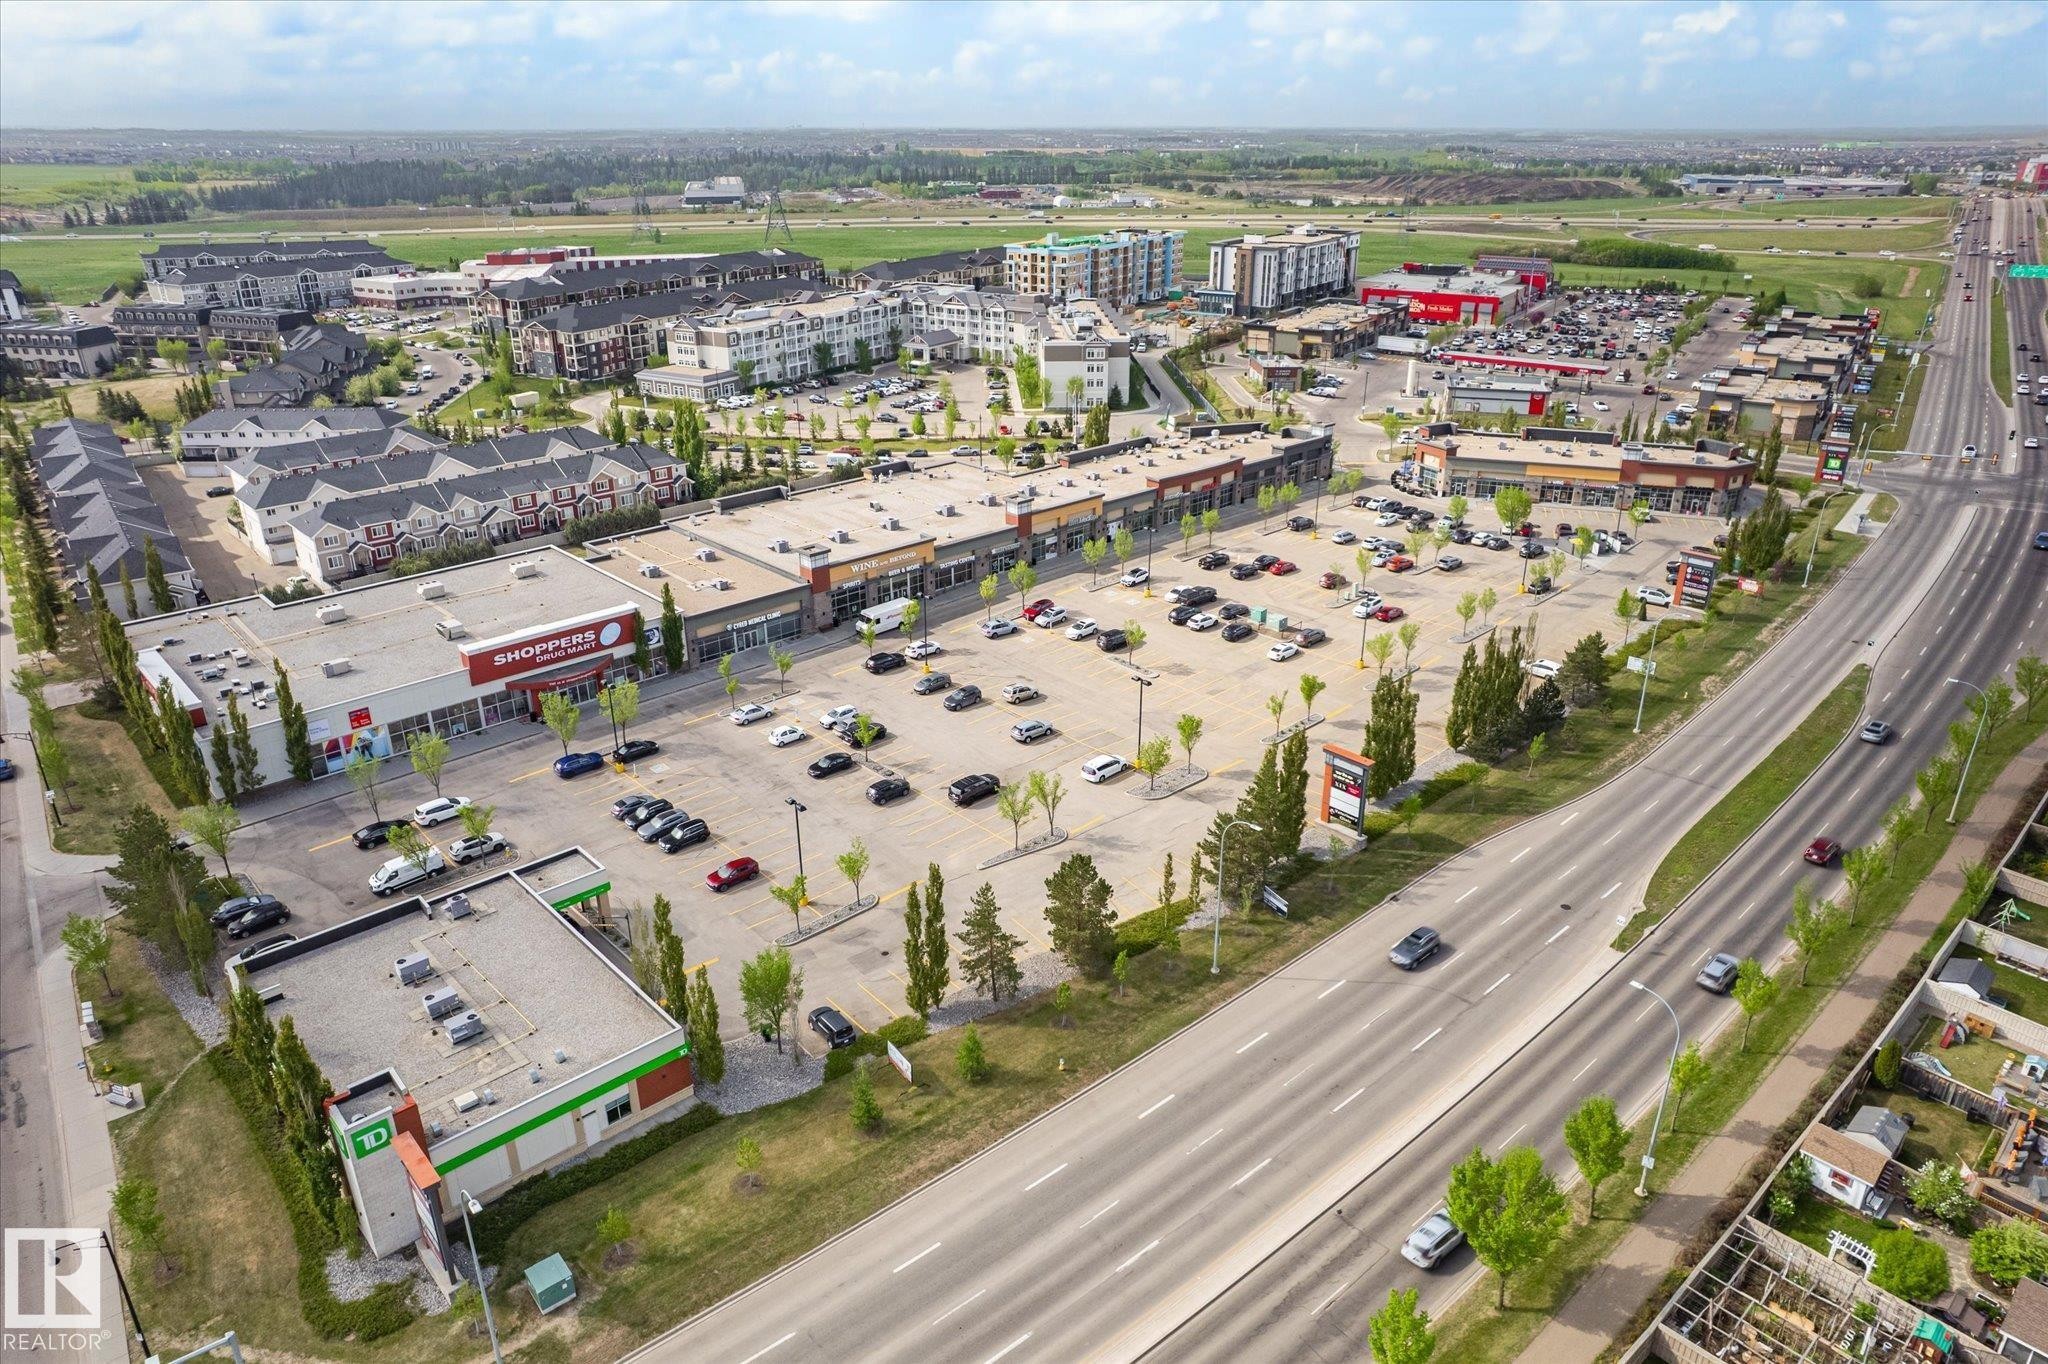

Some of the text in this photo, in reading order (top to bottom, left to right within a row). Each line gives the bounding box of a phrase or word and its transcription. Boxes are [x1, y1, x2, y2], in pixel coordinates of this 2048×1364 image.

[851, 560, 879, 573] WINE
[889, 552, 917, 563] BEYOND
[958, 555, 976, 564] CENTRE
[842, 580, 862, 590] SPIRITS
[748, 615, 767, 625] MEDICAL
[766, 610, 781, 620] CLINIC
[493, 631, 596, 666] SHOPPERS
[536, 641, 597, 663] DRUG MART
[356, 1127, 387, 1150] TD
